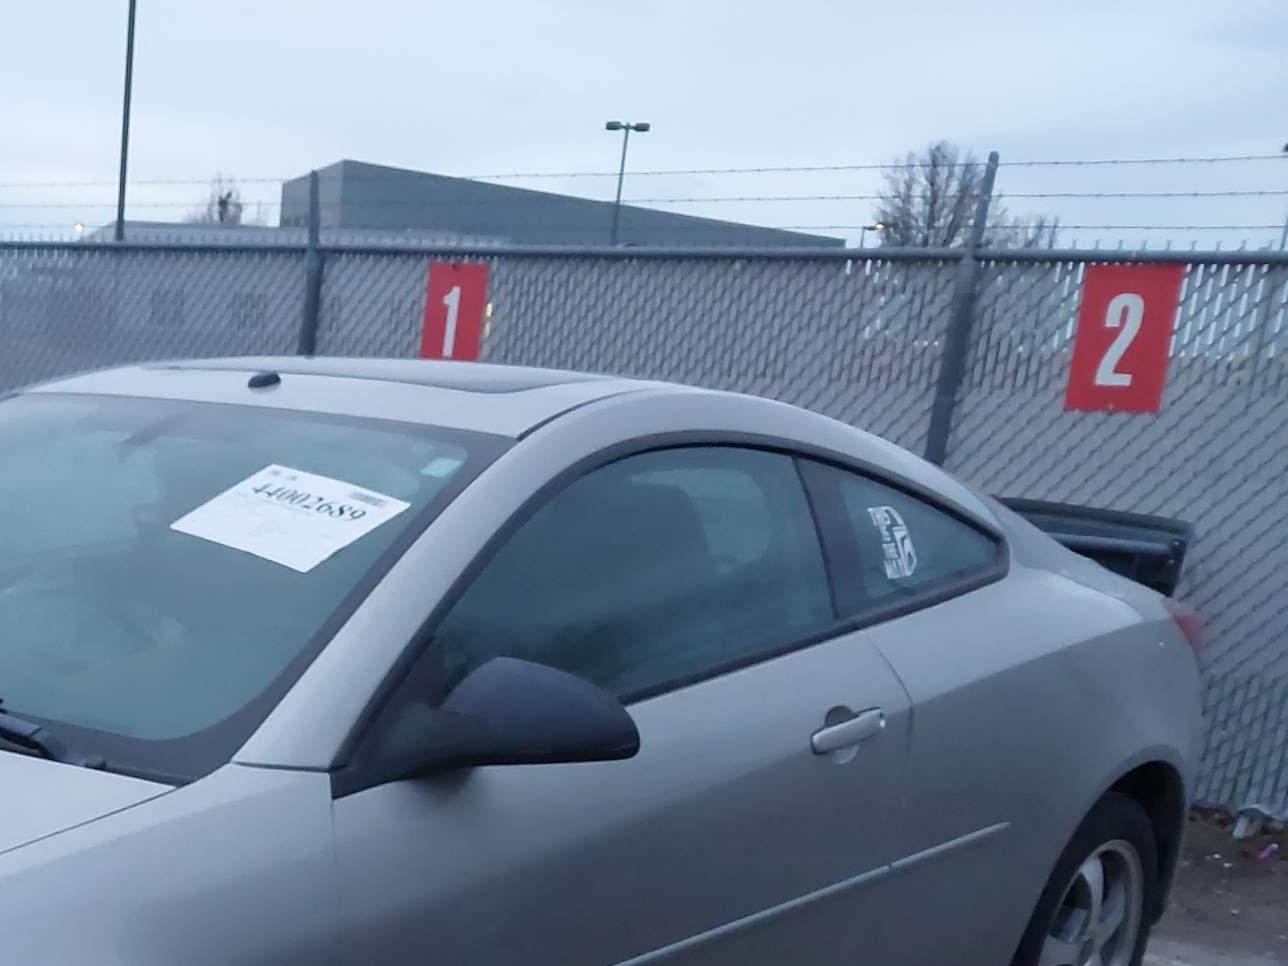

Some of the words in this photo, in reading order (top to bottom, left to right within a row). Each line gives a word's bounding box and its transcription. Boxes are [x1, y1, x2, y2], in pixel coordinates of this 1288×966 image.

[442, 286, 461, 358] 1
[1095, 292, 1145, 387] 2
[252, 483, 367, 521] 44002689
